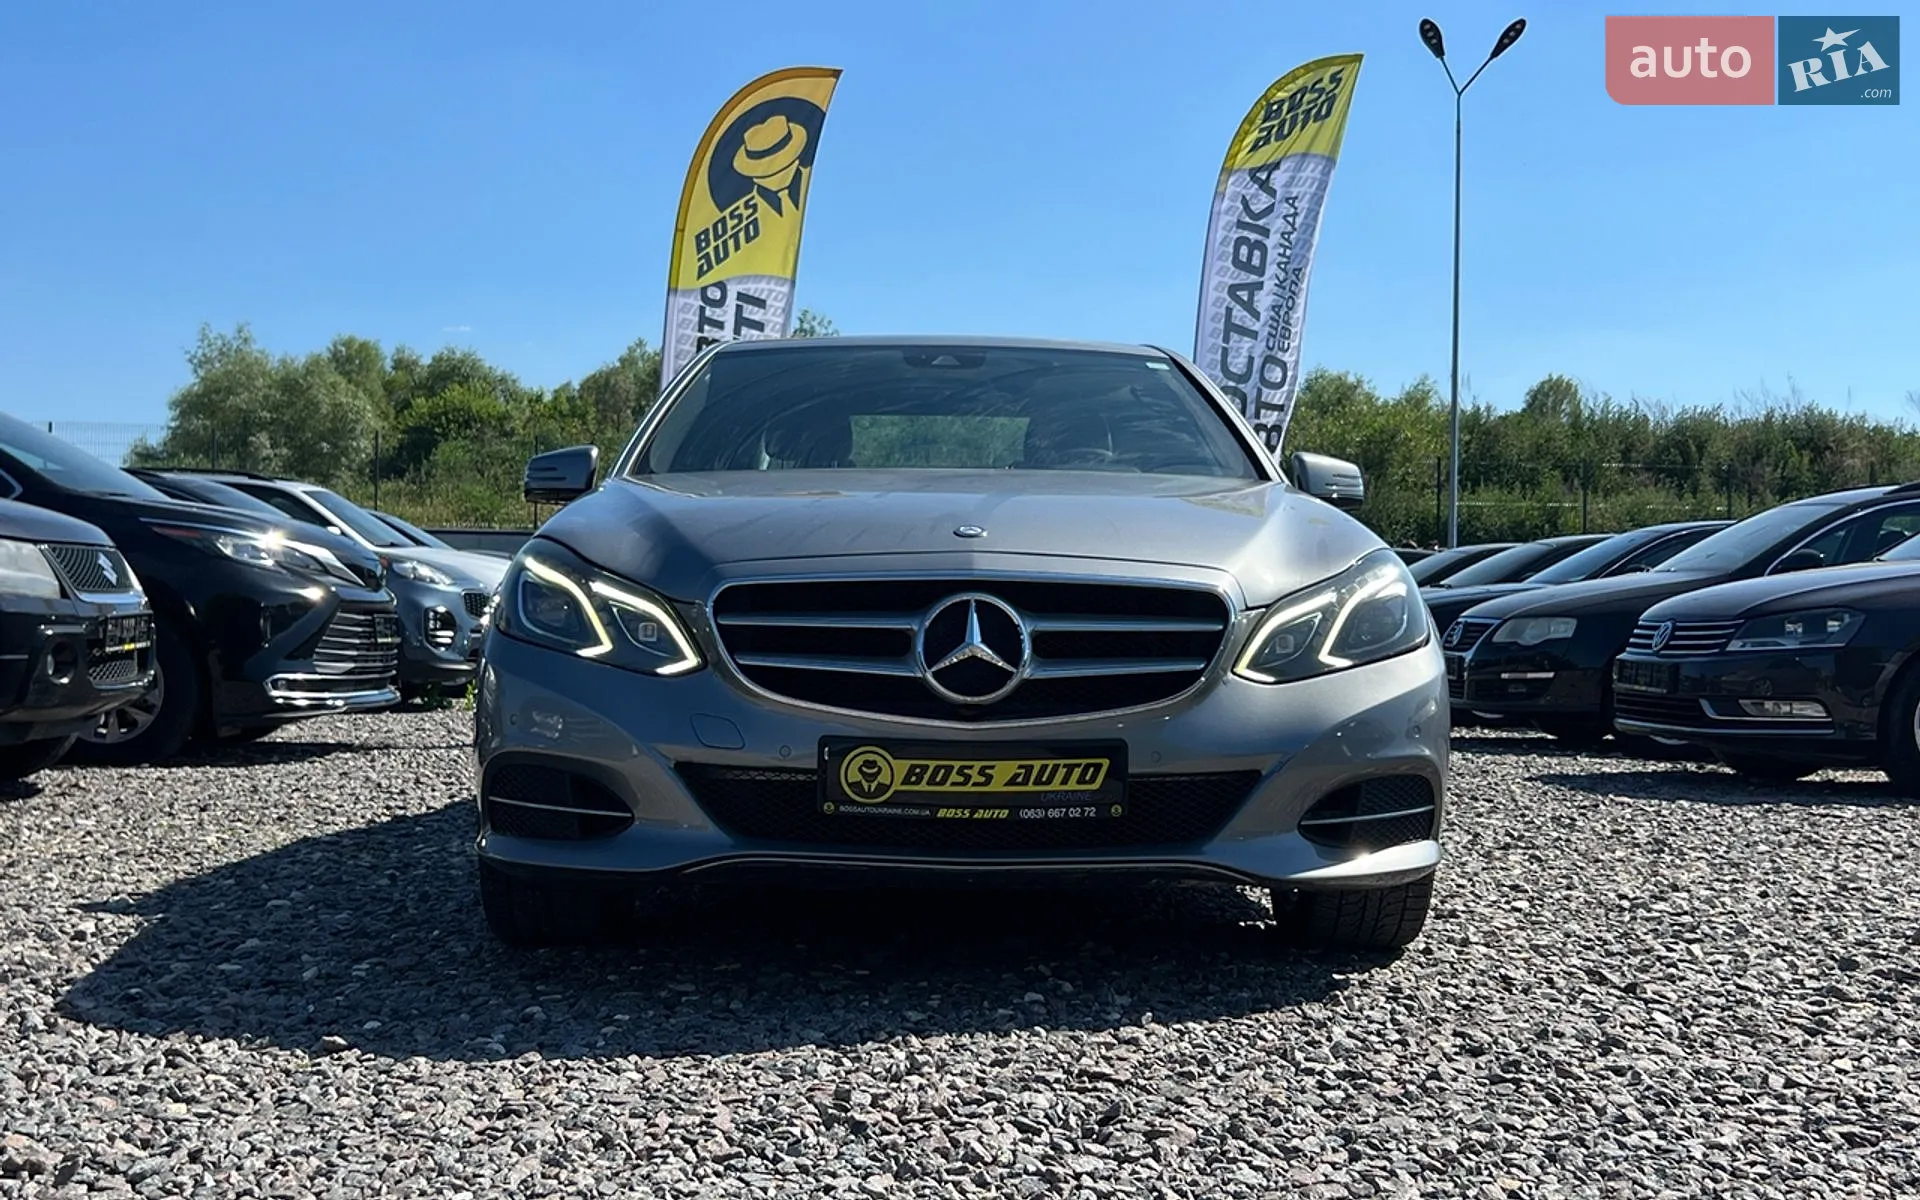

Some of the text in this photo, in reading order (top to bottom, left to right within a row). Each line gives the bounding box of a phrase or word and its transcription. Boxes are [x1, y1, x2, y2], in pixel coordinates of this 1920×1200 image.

[1247, 93, 1337, 155] AUTO
[1261, 67, 1345, 126] BOSS
[694, 194, 758, 257] BOSS
[696, 216, 760, 281] AUTO
[900, 762, 1104, 787] BOSS AUTO
[936, 808, 1009, 818] BOSS AUTO
[1019, 808, 1045, 819] (063)
[1068, 808, 1082, 818] 02
[1084, 807, 1097, 817] 72
